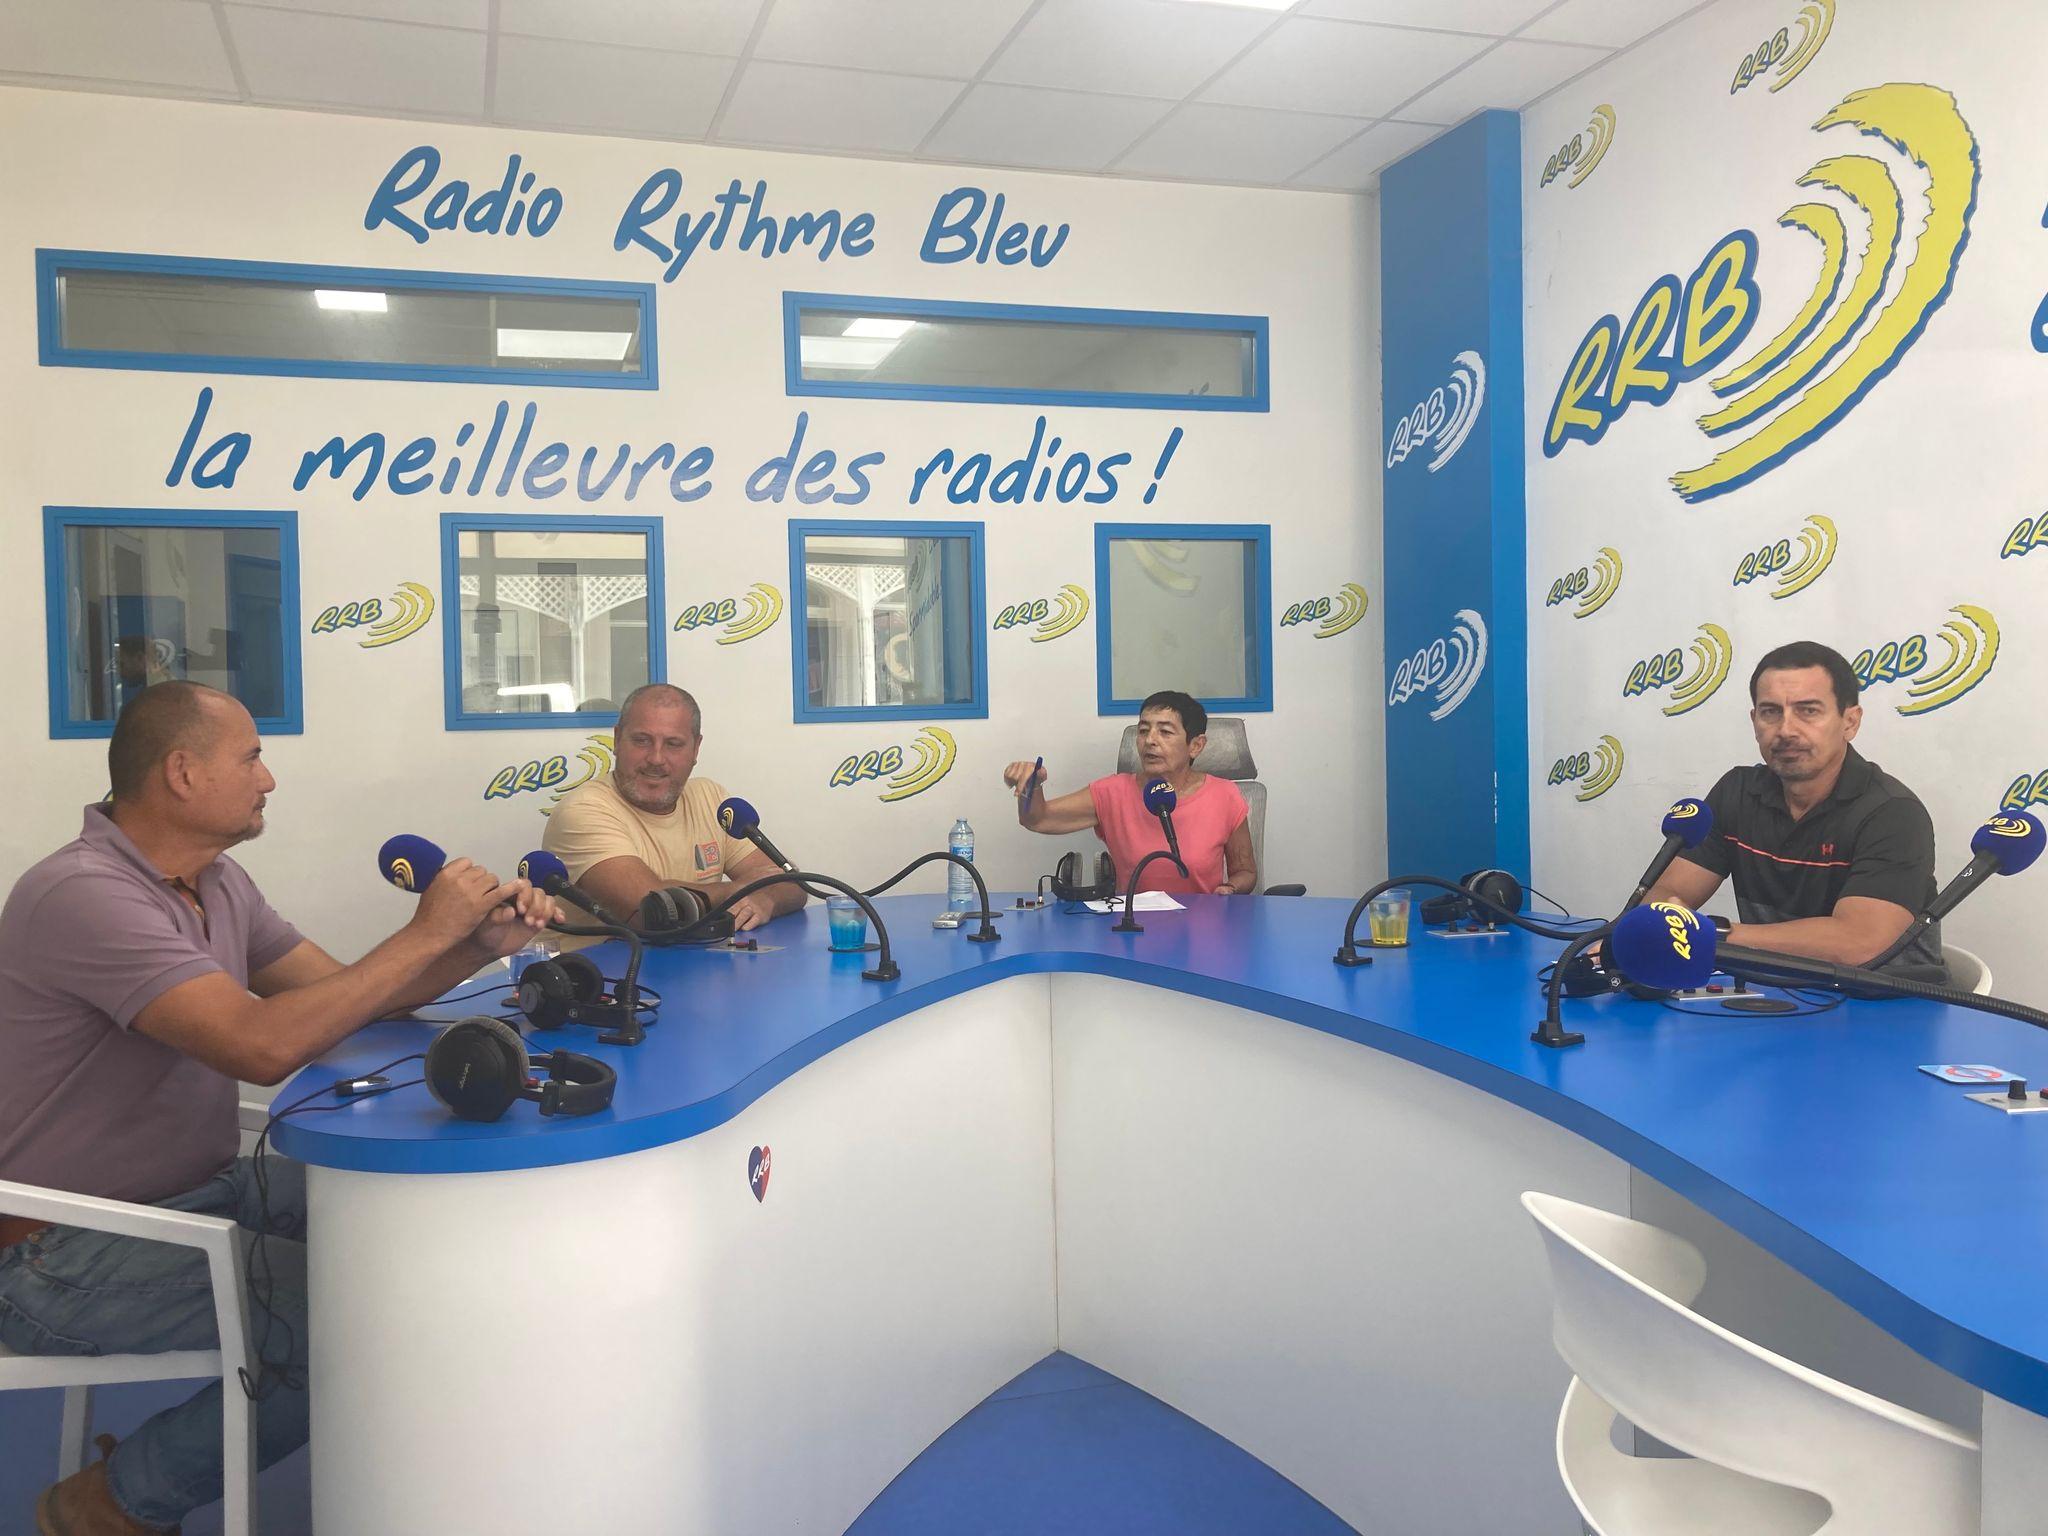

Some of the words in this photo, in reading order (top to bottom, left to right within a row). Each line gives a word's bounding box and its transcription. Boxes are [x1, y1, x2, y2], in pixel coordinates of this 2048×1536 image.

[1730, 26, 1789, 95] RRB
[1540, 133, 1582, 188] RRB
[365, 146, 562, 243] Radio
[614, 168, 875, 283] Rythme
[919, 187, 1070, 268] Bleu
[1543, 229, 1760, 458] RRB
[165, 387, 252, 489] la
[292, 400, 715, 502] meilleure
[746, 411, 885, 505] des
[1387, 387, 1446, 469] RRB
[2000, 517, 2048, 560] RR
[1733, 538, 1791, 586] RRB
[1546, 566, 1588, 607] RRB
[311, 598, 383, 634] RRB
[673, 598, 737, 632] RRB
[993, 598, 1049, 630] RRB
[1280, 596, 1331, 627] RRB
[1389, 638, 1447, 707] RRB
[1623, 648, 1684, 697] RRB
[484, 755, 569, 801] RRB
[829, 745, 904, 788] RRB
[1548, 751, 1590, 785] RRB
[1665, 915, 1692, 960] RRB
